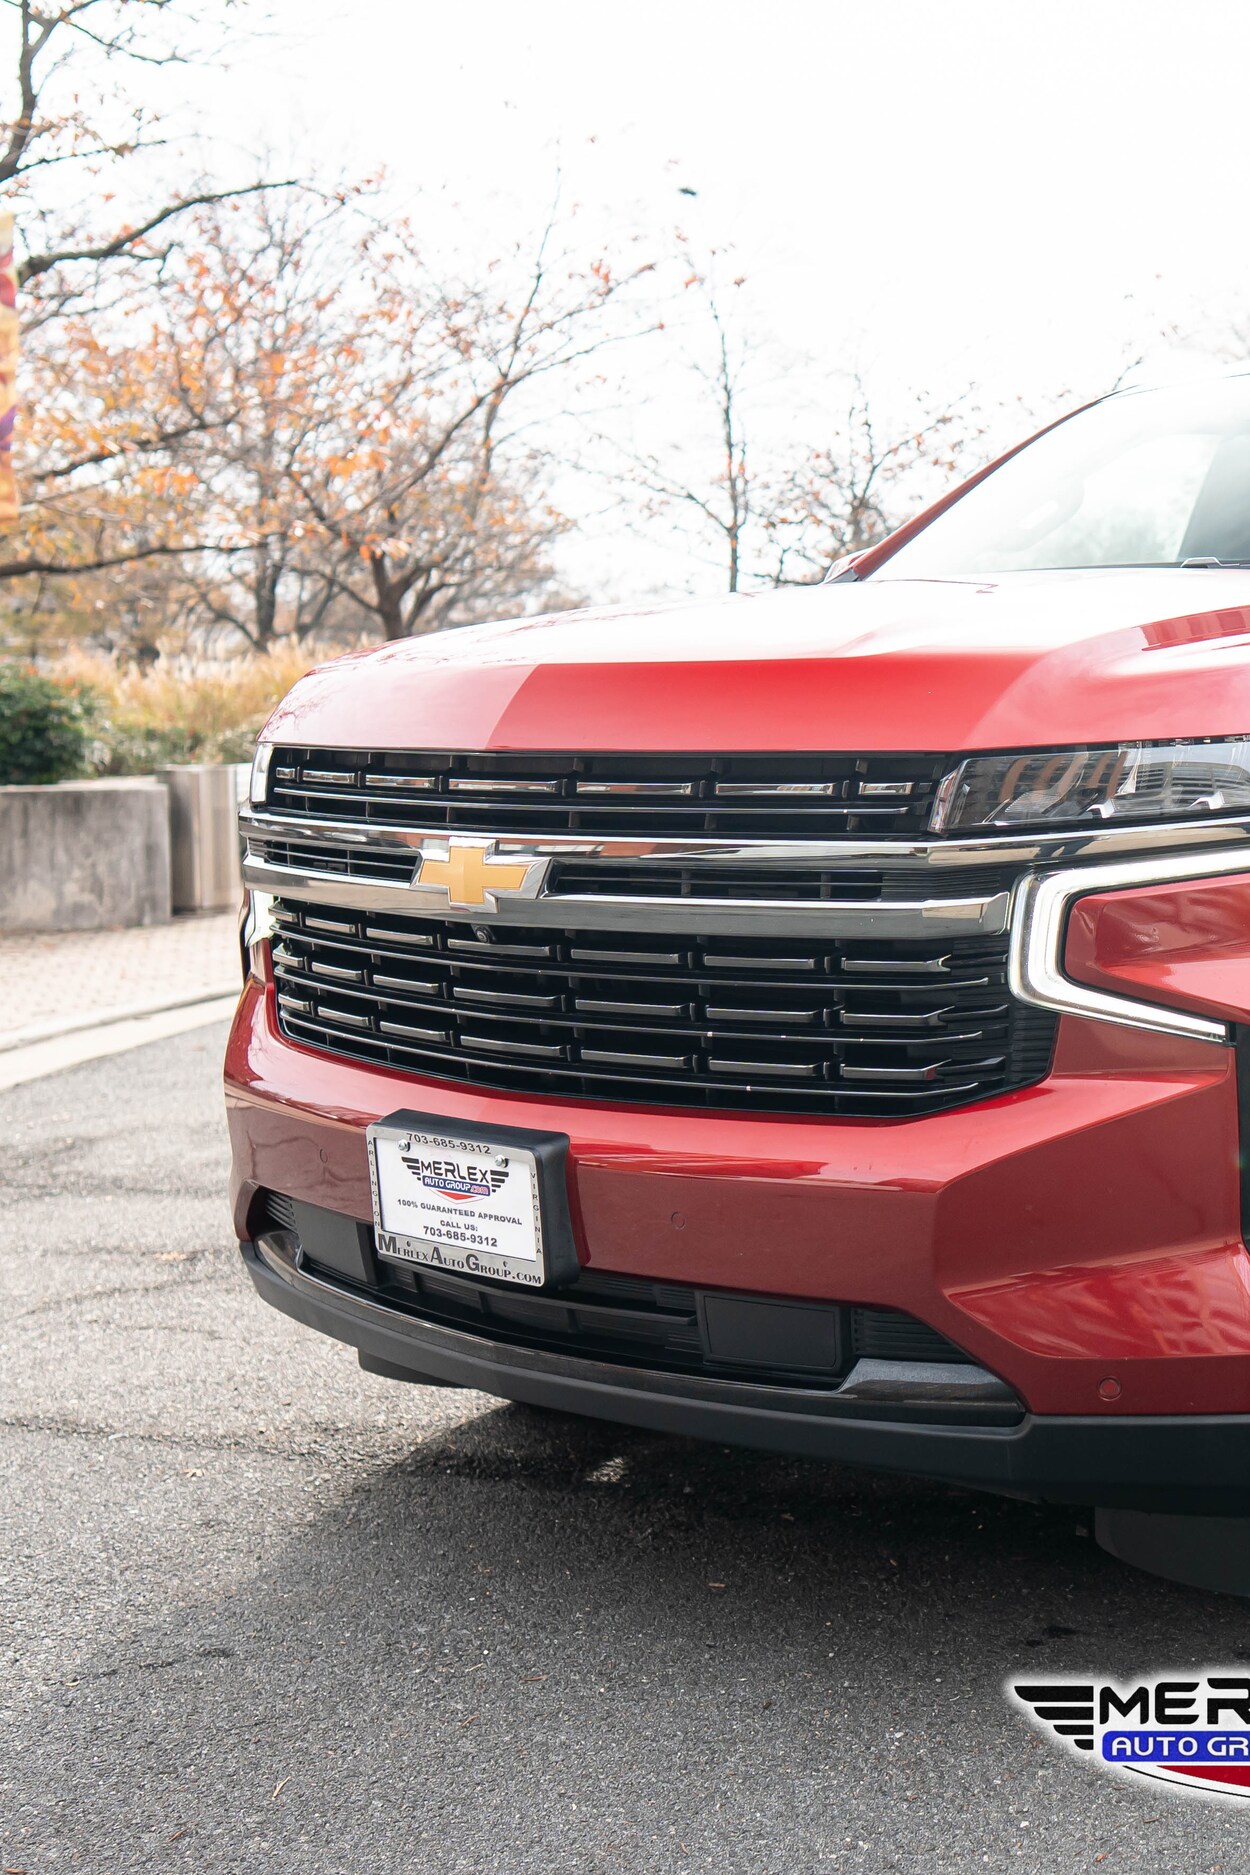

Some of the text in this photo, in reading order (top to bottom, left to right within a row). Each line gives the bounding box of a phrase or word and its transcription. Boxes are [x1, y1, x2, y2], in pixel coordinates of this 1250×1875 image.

[406, 1132, 492, 1155] 703-685-9312
[367, 1139, 381, 1227] ARLINGTON
[420, 1160, 490, 1184] MERLEX
[423, 1177, 444, 1188] AUTO
[397, 1199, 523, 1225] 100% GUARANTEED APPROVAL
[530, 1172, 543, 1254] VIRGINIA
[423, 1226, 498, 1247] 703-685-9312
[440, 1219, 478, 1232] CALL US:
